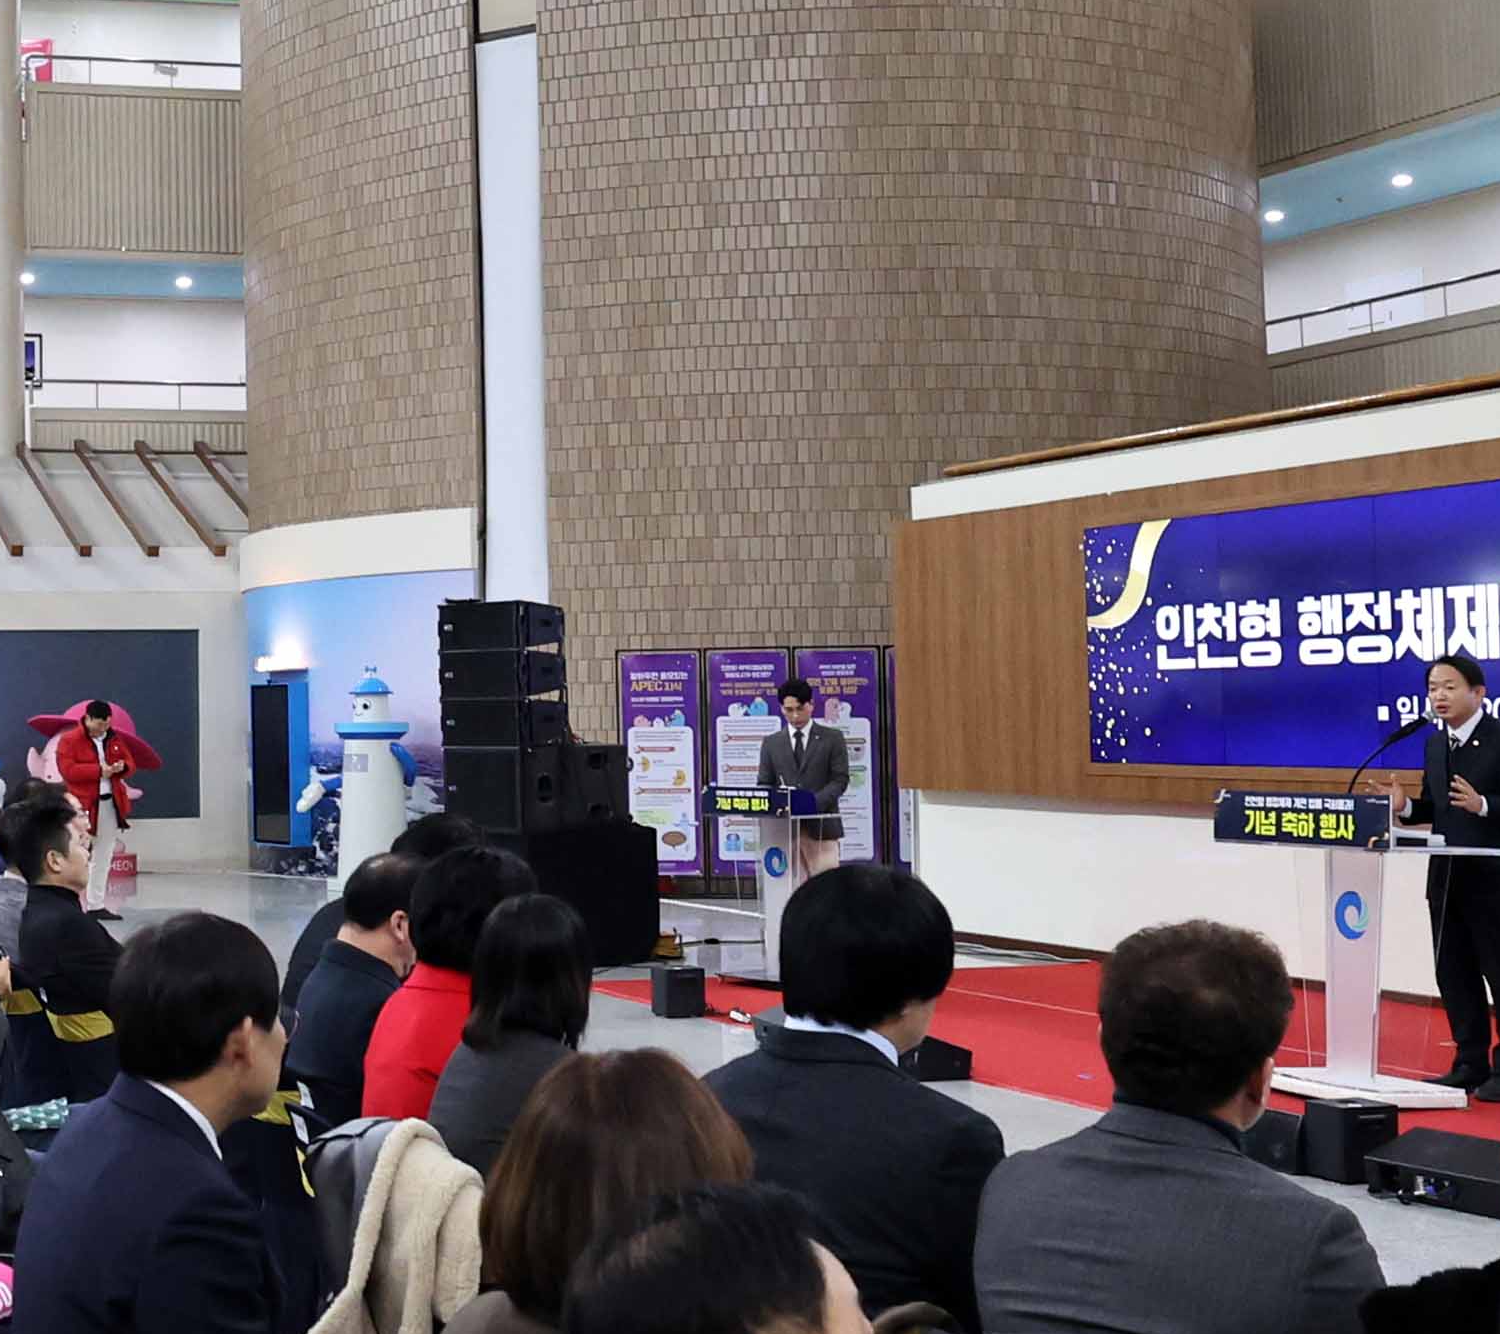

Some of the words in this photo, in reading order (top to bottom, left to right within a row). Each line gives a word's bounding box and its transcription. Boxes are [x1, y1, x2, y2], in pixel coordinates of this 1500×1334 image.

[1155, 598, 1282, 670] 인천형
[1297, 584, 1500, 662] 행정체제
[1244, 810, 1277, 836] 기념
[1281, 811, 1315, 838] 축하
[1319, 813, 1355, 840] 행사
